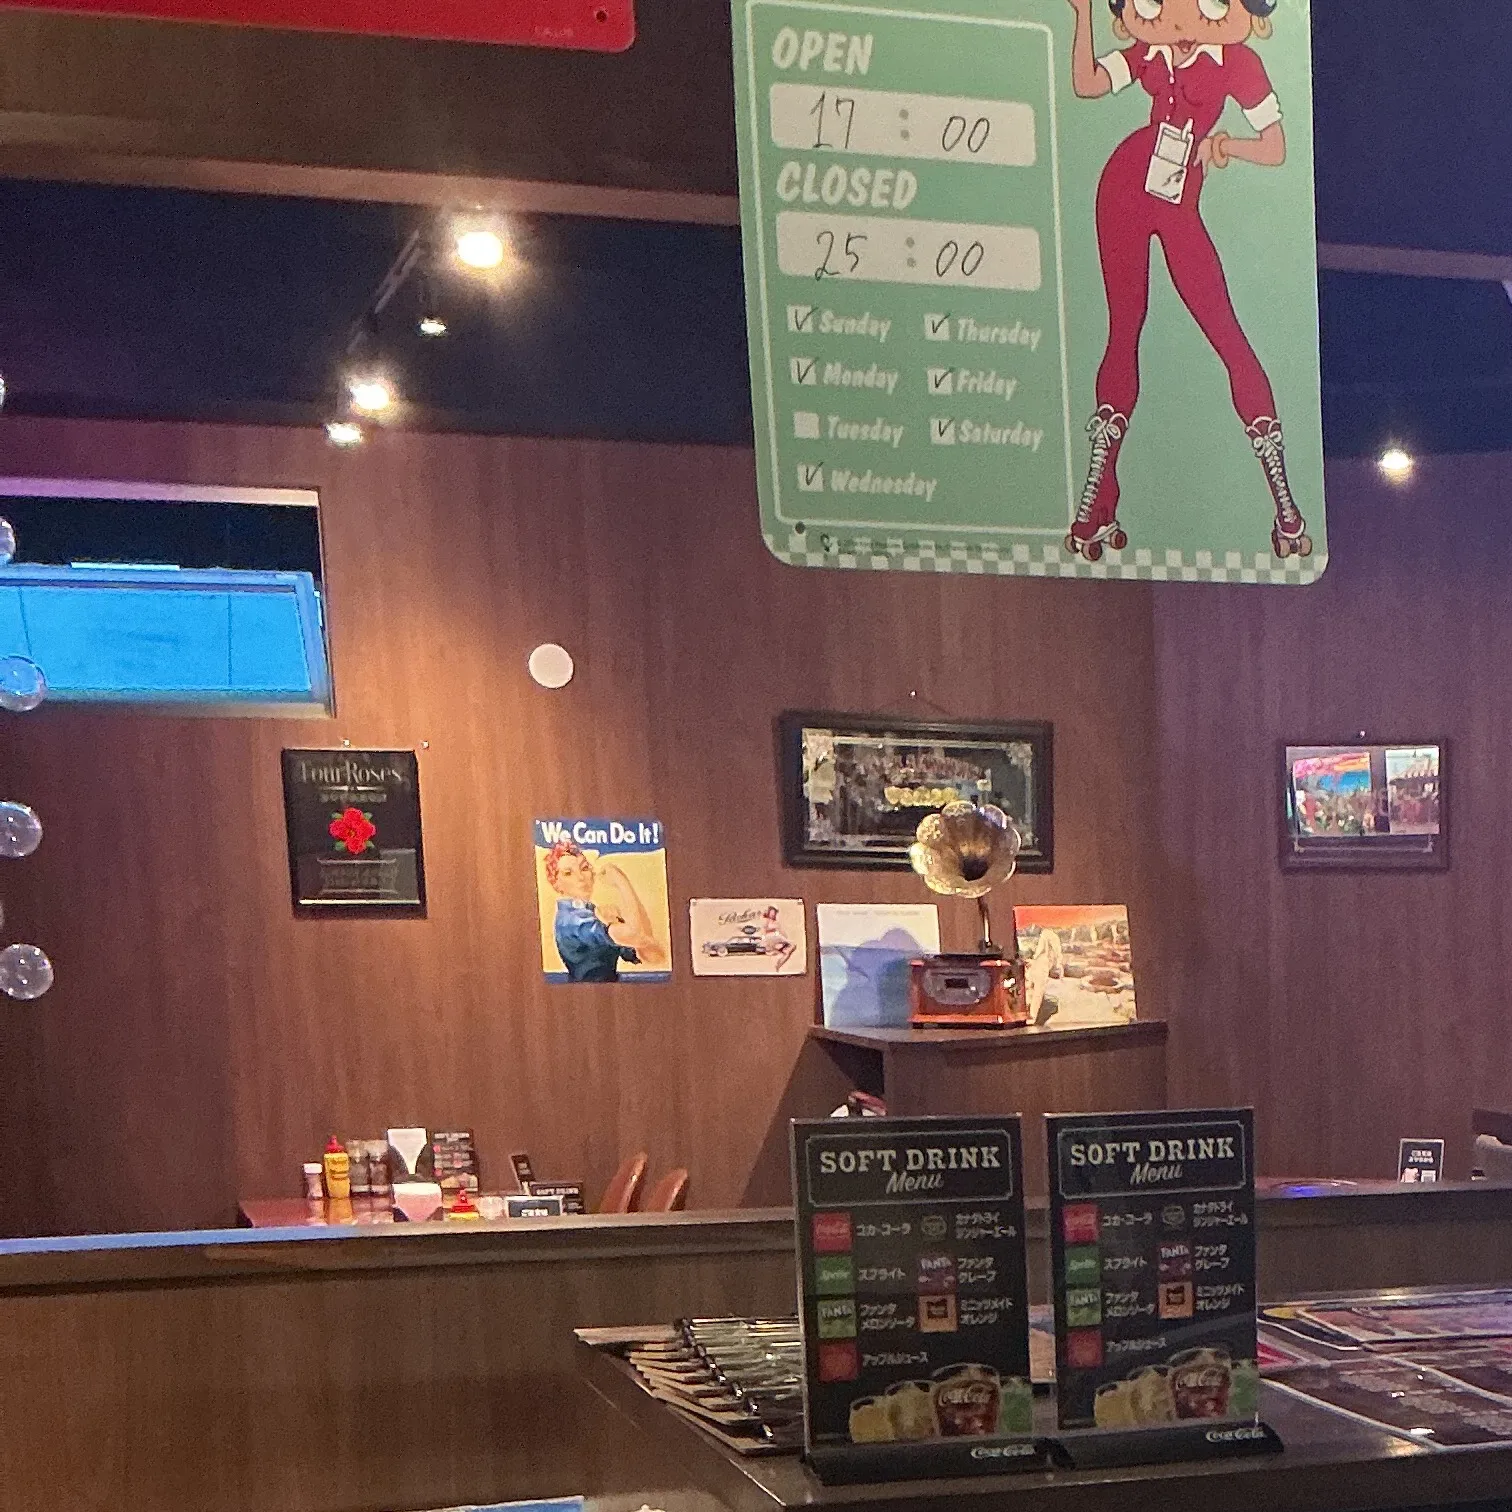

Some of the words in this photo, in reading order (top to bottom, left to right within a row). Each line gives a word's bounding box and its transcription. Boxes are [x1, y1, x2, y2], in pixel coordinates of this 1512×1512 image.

[772, 27, 873, 75] OPEN
[811, 92, 855, 150] 17
[942, 113, 990, 154] 00
[776, 160, 918, 211] CLOSED
[813, 229, 867, 280] 25
[935, 240, 985, 278] 00
[818, 310, 892, 344] Sunday
[957, 317, 1041, 352] Thursday
[824, 363, 898, 395] Monday
[957, 368, 1018, 401] Friday
[827, 414, 904, 448] Tuesday
[959, 421, 1044, 452] Saturday
[831, 470, 937, 501] Wednesday
[345, 760, 402, 783] Roses
[541, 821, 571, 843] We
[573, 821, 608, 844] Can
[610, 821, 636, 844] Do
[639, 822, 659, 844] It!
[820, 1150, 897, 1173] SOFT
[906, 1146, 1000, 1170] DRINK
[1070, 1141, 1141, 1166] SOFT
[1149, 1137, 1234, 1162] DRINK
[886, 1171, 945, 1194] Menu
[1130, 1162, 1183, 1185] Menu
